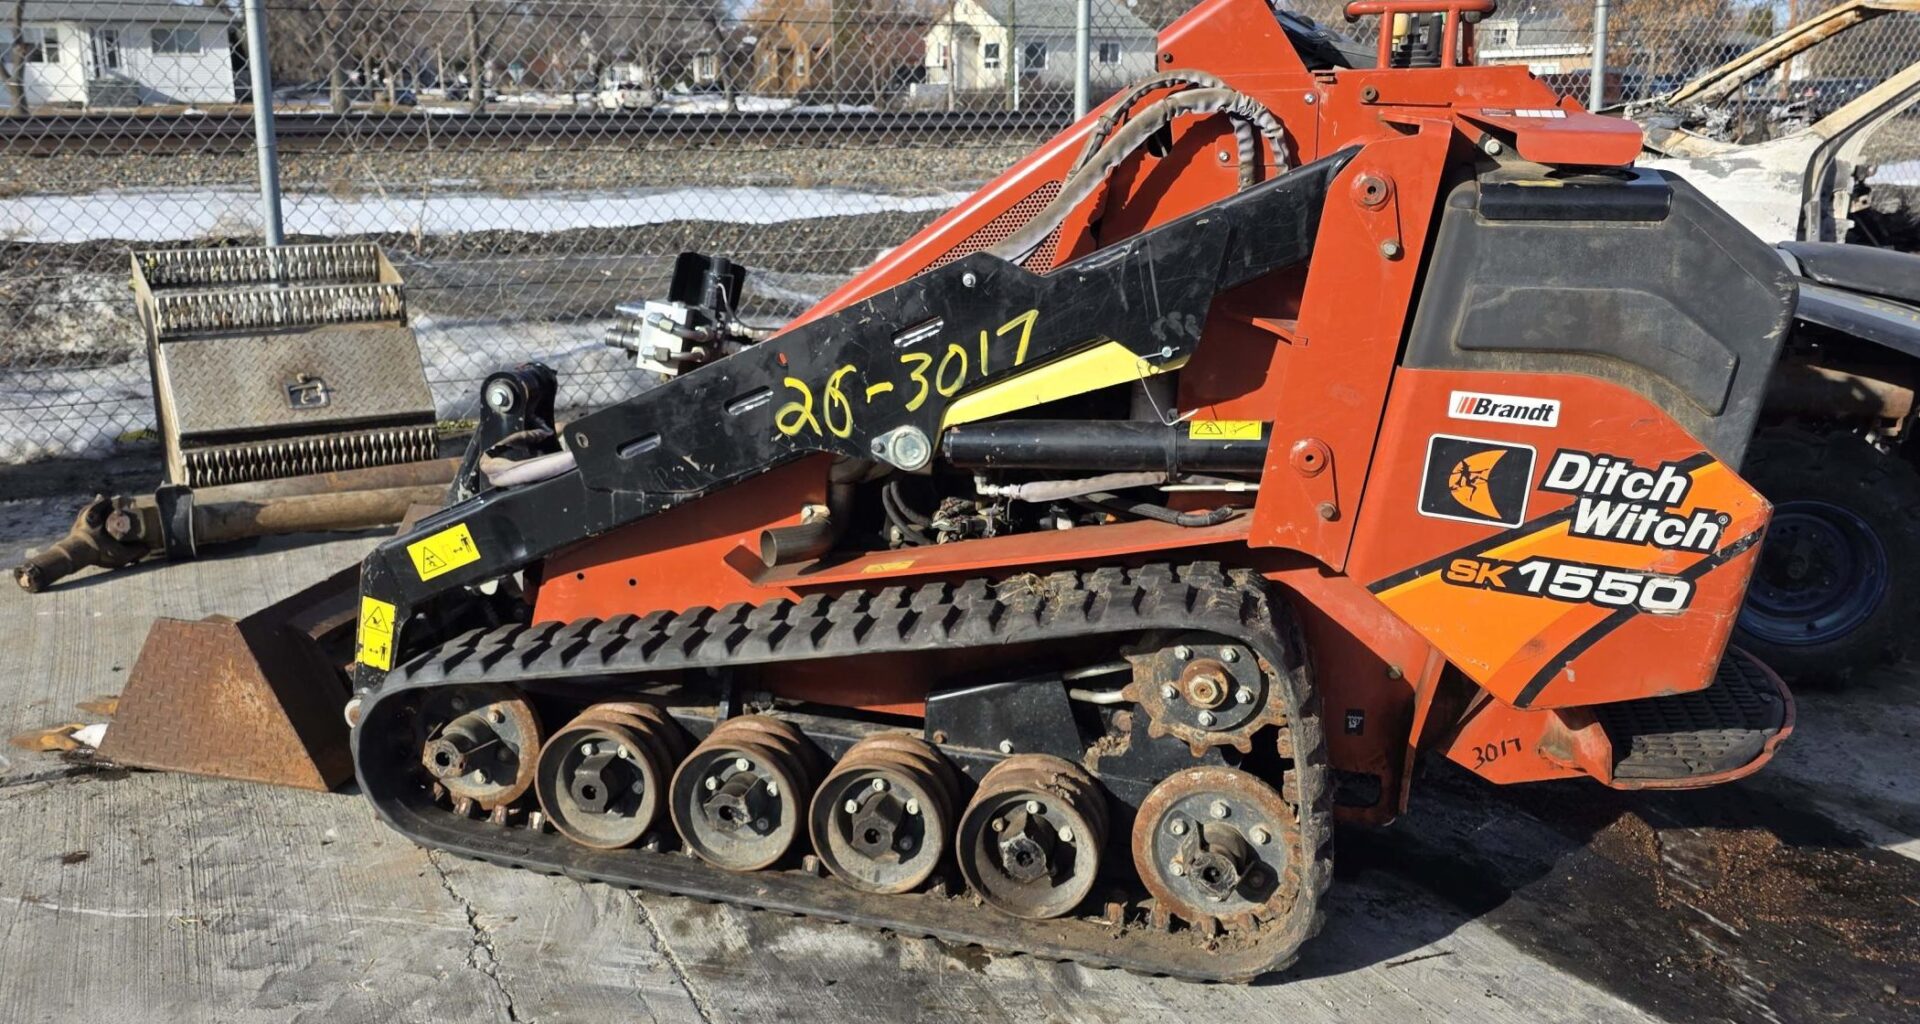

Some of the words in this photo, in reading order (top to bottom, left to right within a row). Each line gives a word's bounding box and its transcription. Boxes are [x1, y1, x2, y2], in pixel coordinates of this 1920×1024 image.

[1473, 397, 1554, 422] Brandt
[1544, 452, 1688, 504] Ditch
[1446, 558, 1513, 588] SK
[1518, 560, 1691, 616] 1550
[1471, 737, 1522, 770] 3017
